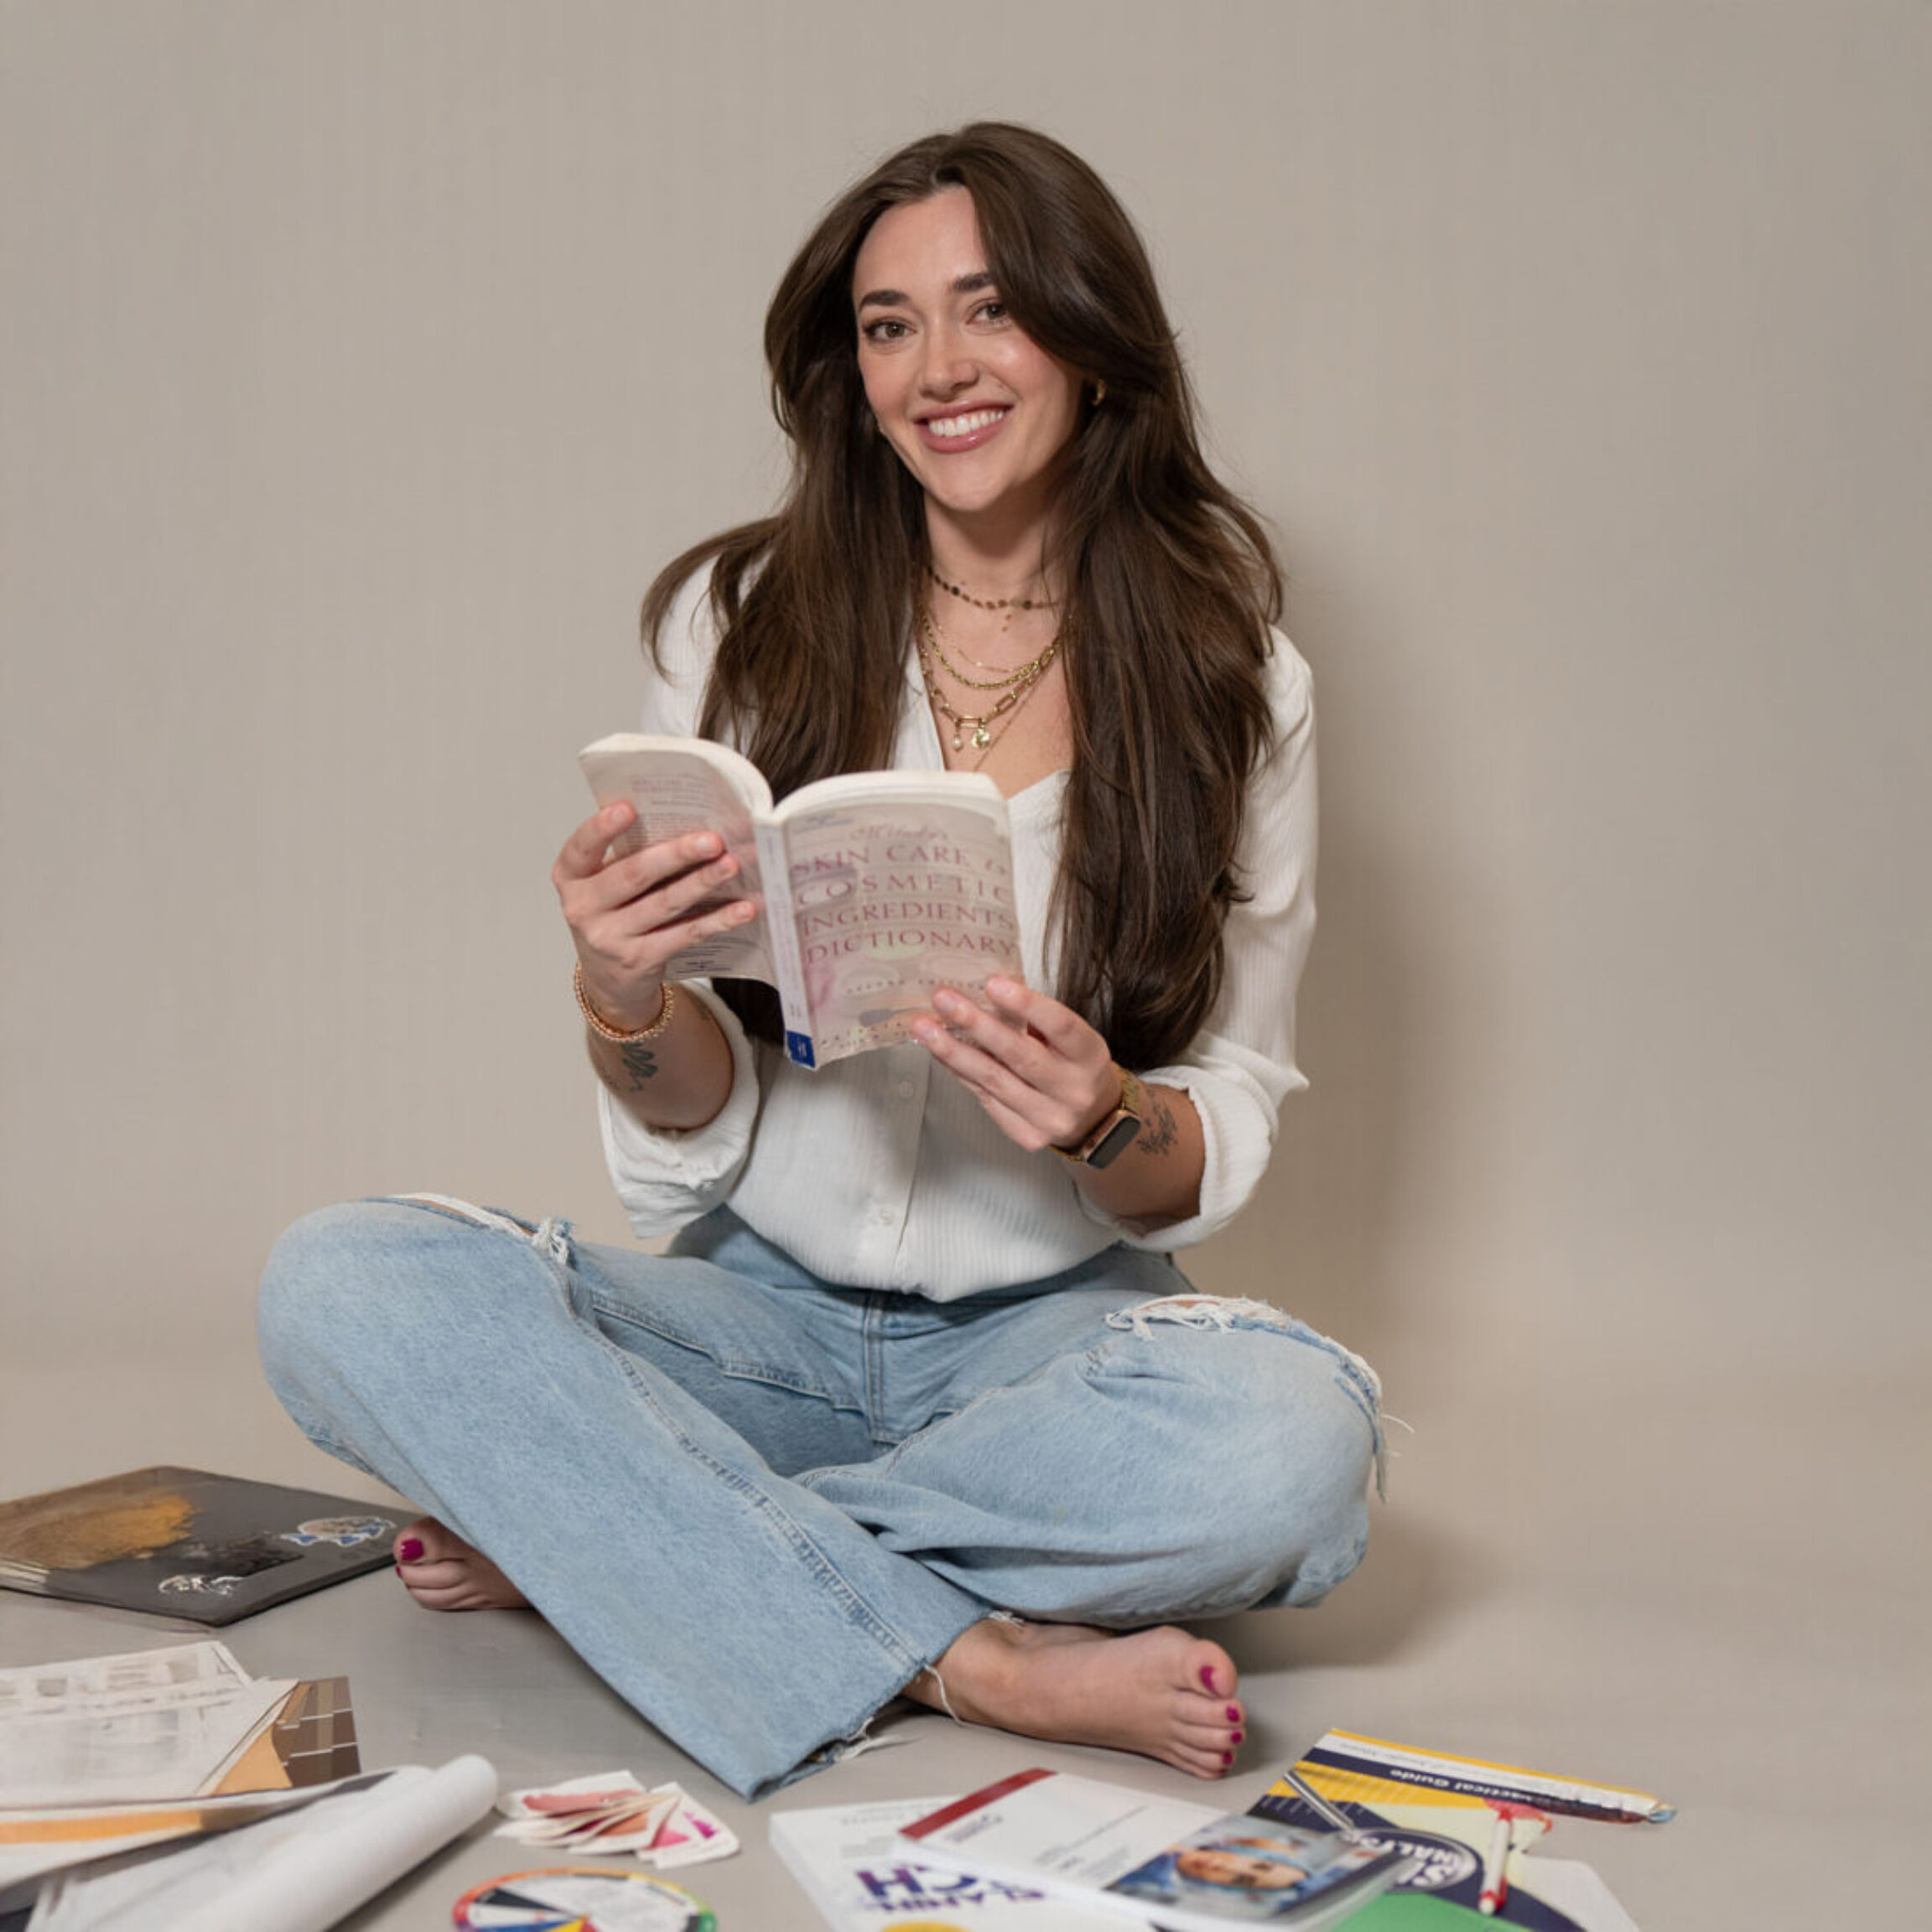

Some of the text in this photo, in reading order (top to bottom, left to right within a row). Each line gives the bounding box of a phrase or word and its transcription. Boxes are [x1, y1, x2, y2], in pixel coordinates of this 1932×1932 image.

[789, 846, 870, 874] SKIN
[886, 843, 970, 866] CARE
[797, 873, 1012, 906] COSMETIC
[802, 901, 1015, 937] INGREDIENTS
[806, 929, 1018, 963] DICTIONARY
[1389, 1767, 1451, 1788] Guide
